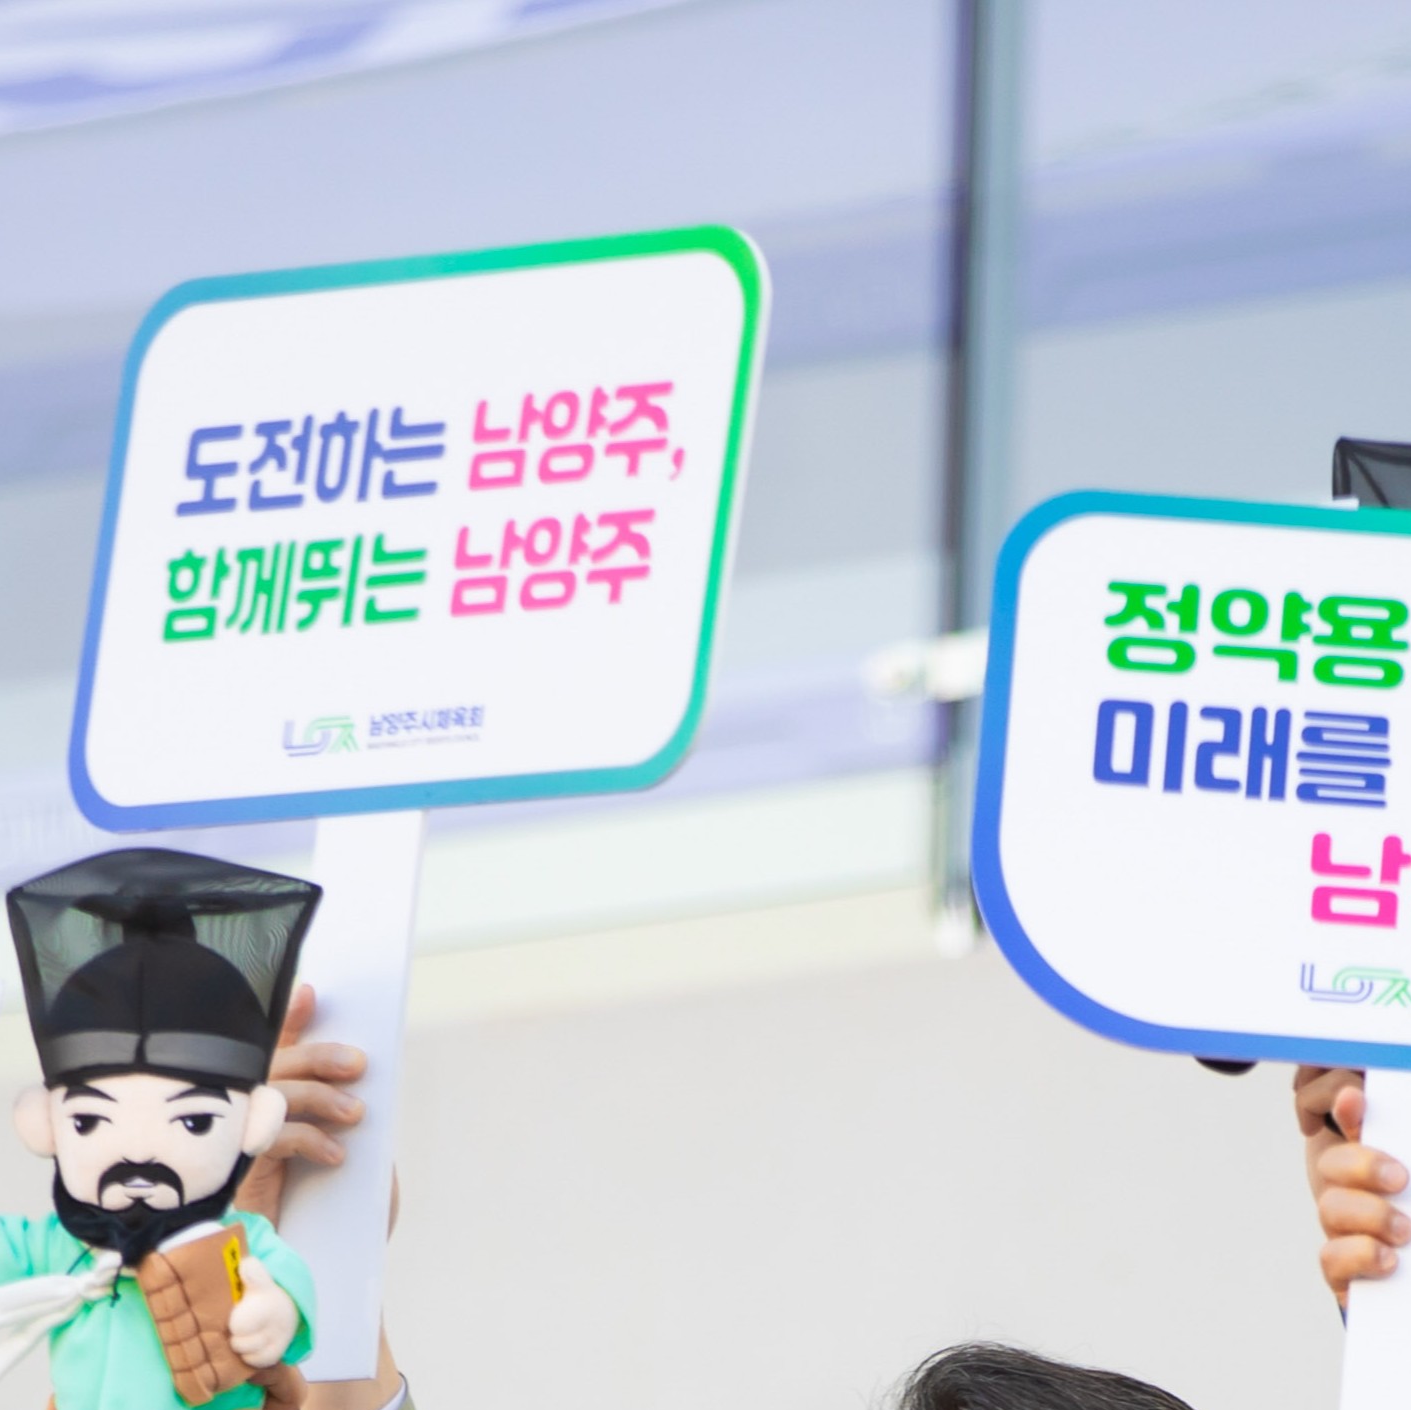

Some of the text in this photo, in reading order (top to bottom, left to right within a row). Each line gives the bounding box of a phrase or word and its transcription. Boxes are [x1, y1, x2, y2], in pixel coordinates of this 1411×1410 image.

[175, 381, 685, 517] 도전하는 남양주,
[163, 508, 657, 643] 함께뛰는 남양주
[1092, 698, 1392, 809] 미래를
